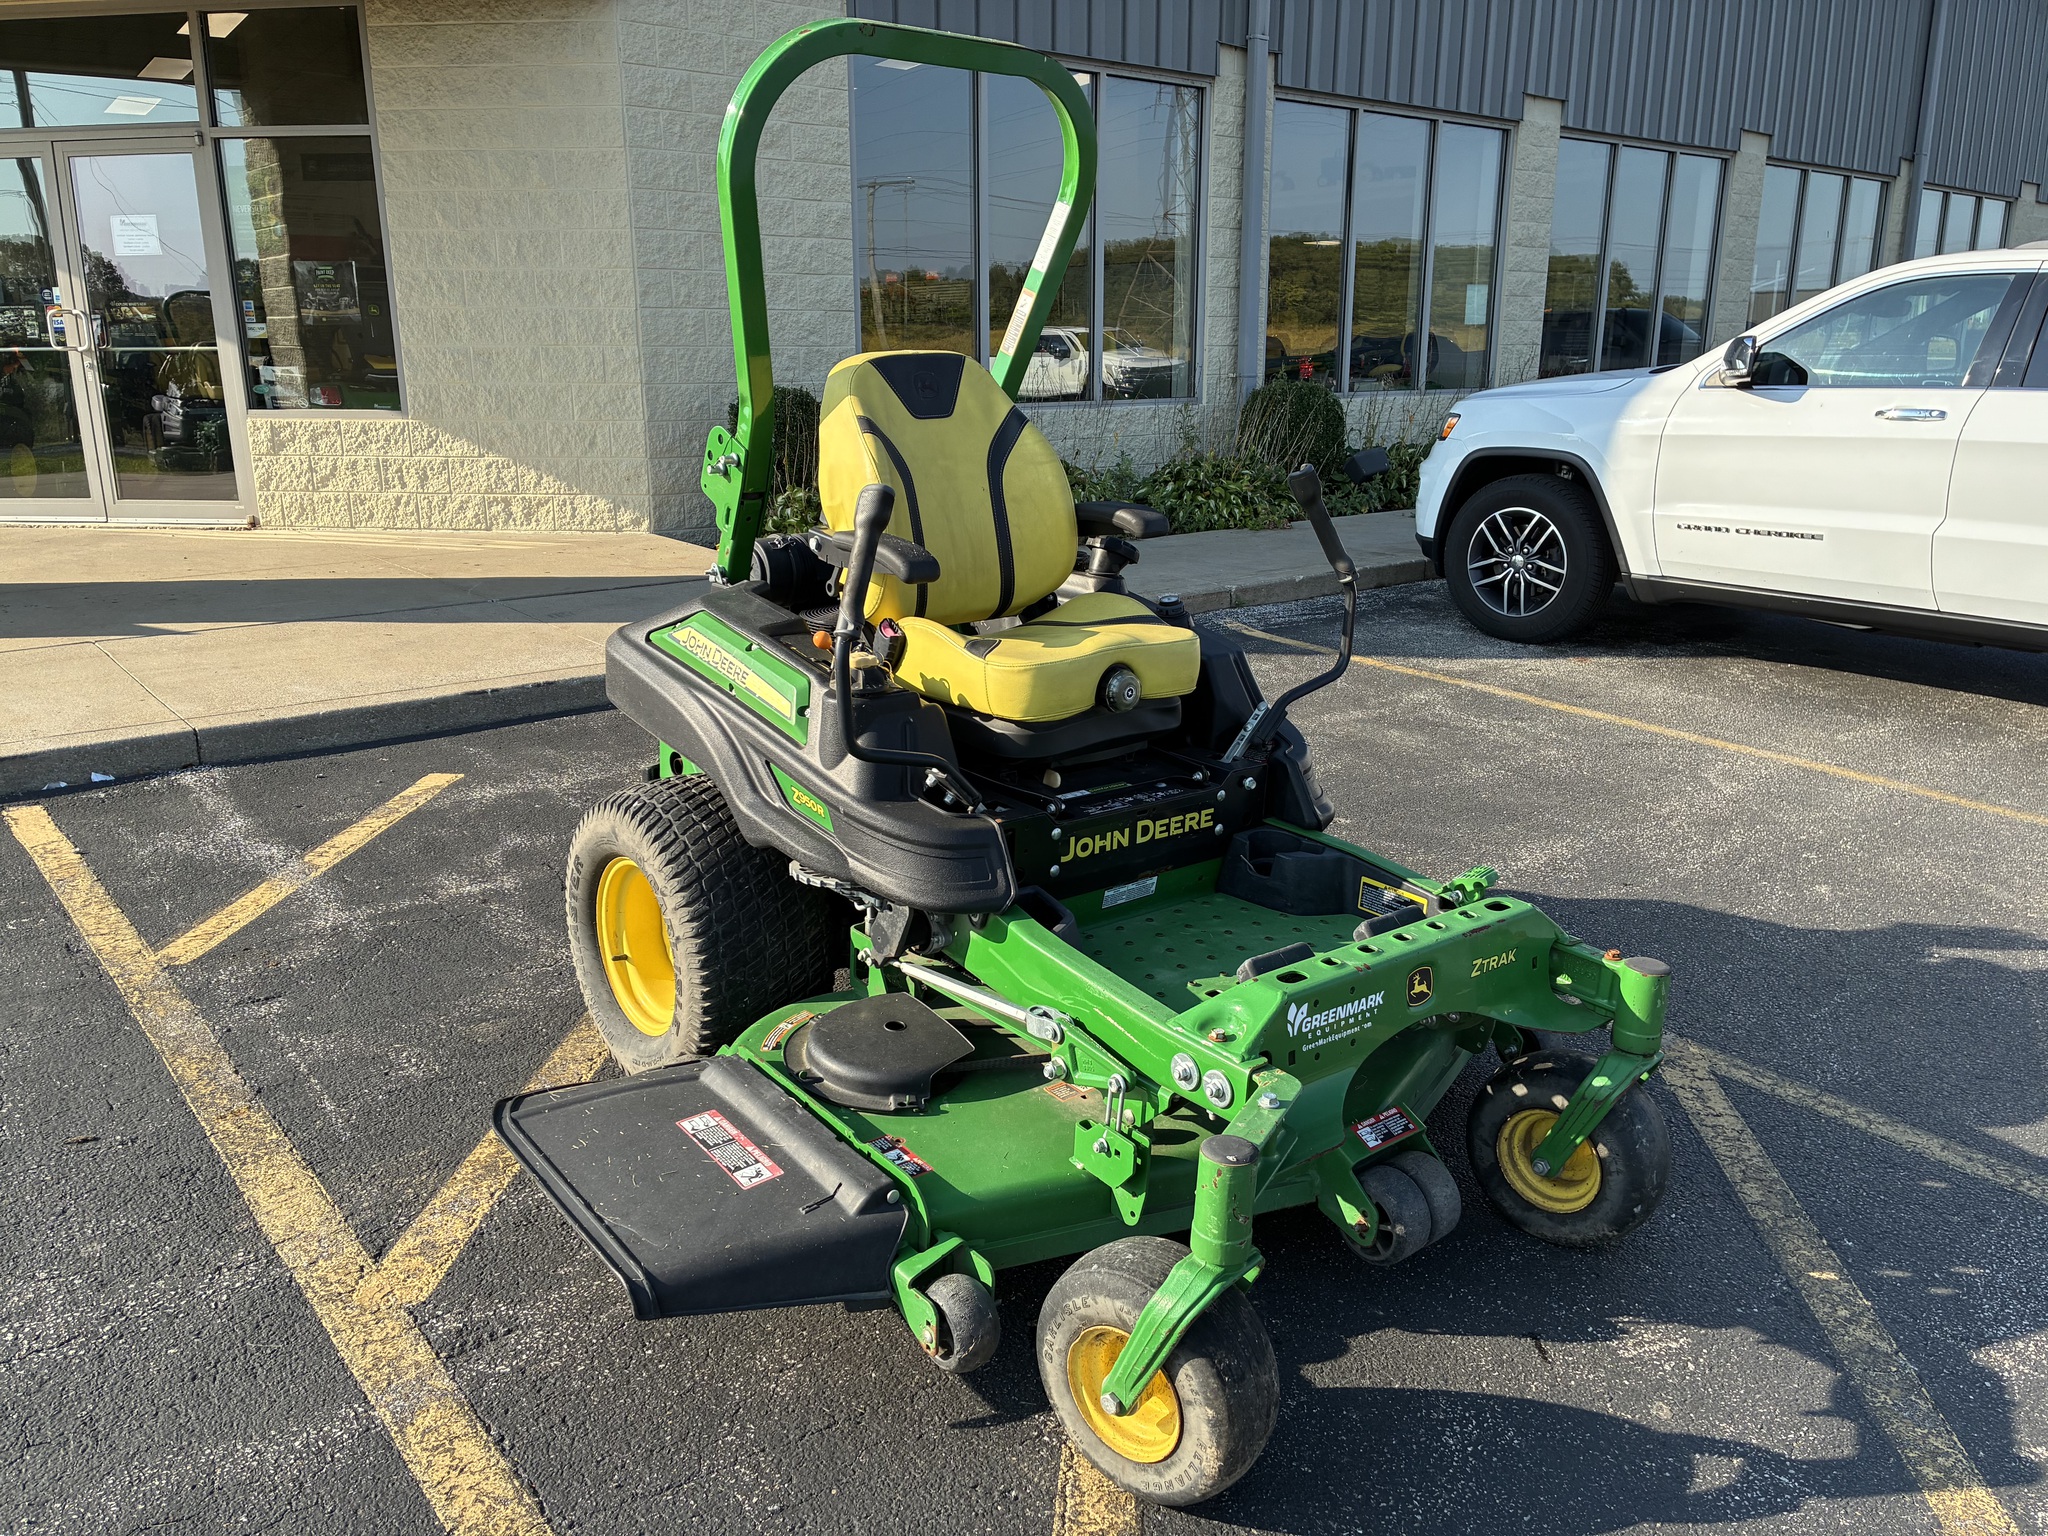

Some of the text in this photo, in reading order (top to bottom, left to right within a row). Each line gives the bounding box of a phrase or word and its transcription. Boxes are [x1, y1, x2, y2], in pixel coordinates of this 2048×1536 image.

[1677, 523, 1824, 541] GRAND CHEROKEE
[681, 630, 749, 686] JOHN DEERE
[791, 785, 826, 819] Z950R
[1061, 808, 1215, 863] JOHN DEERE
[1471, 947, 1517, 978] ZTRAK
[1301, 990, 1385, 1033] GREENMARK
[1307, 1008, 1378, 1039] EQUIPMENT
